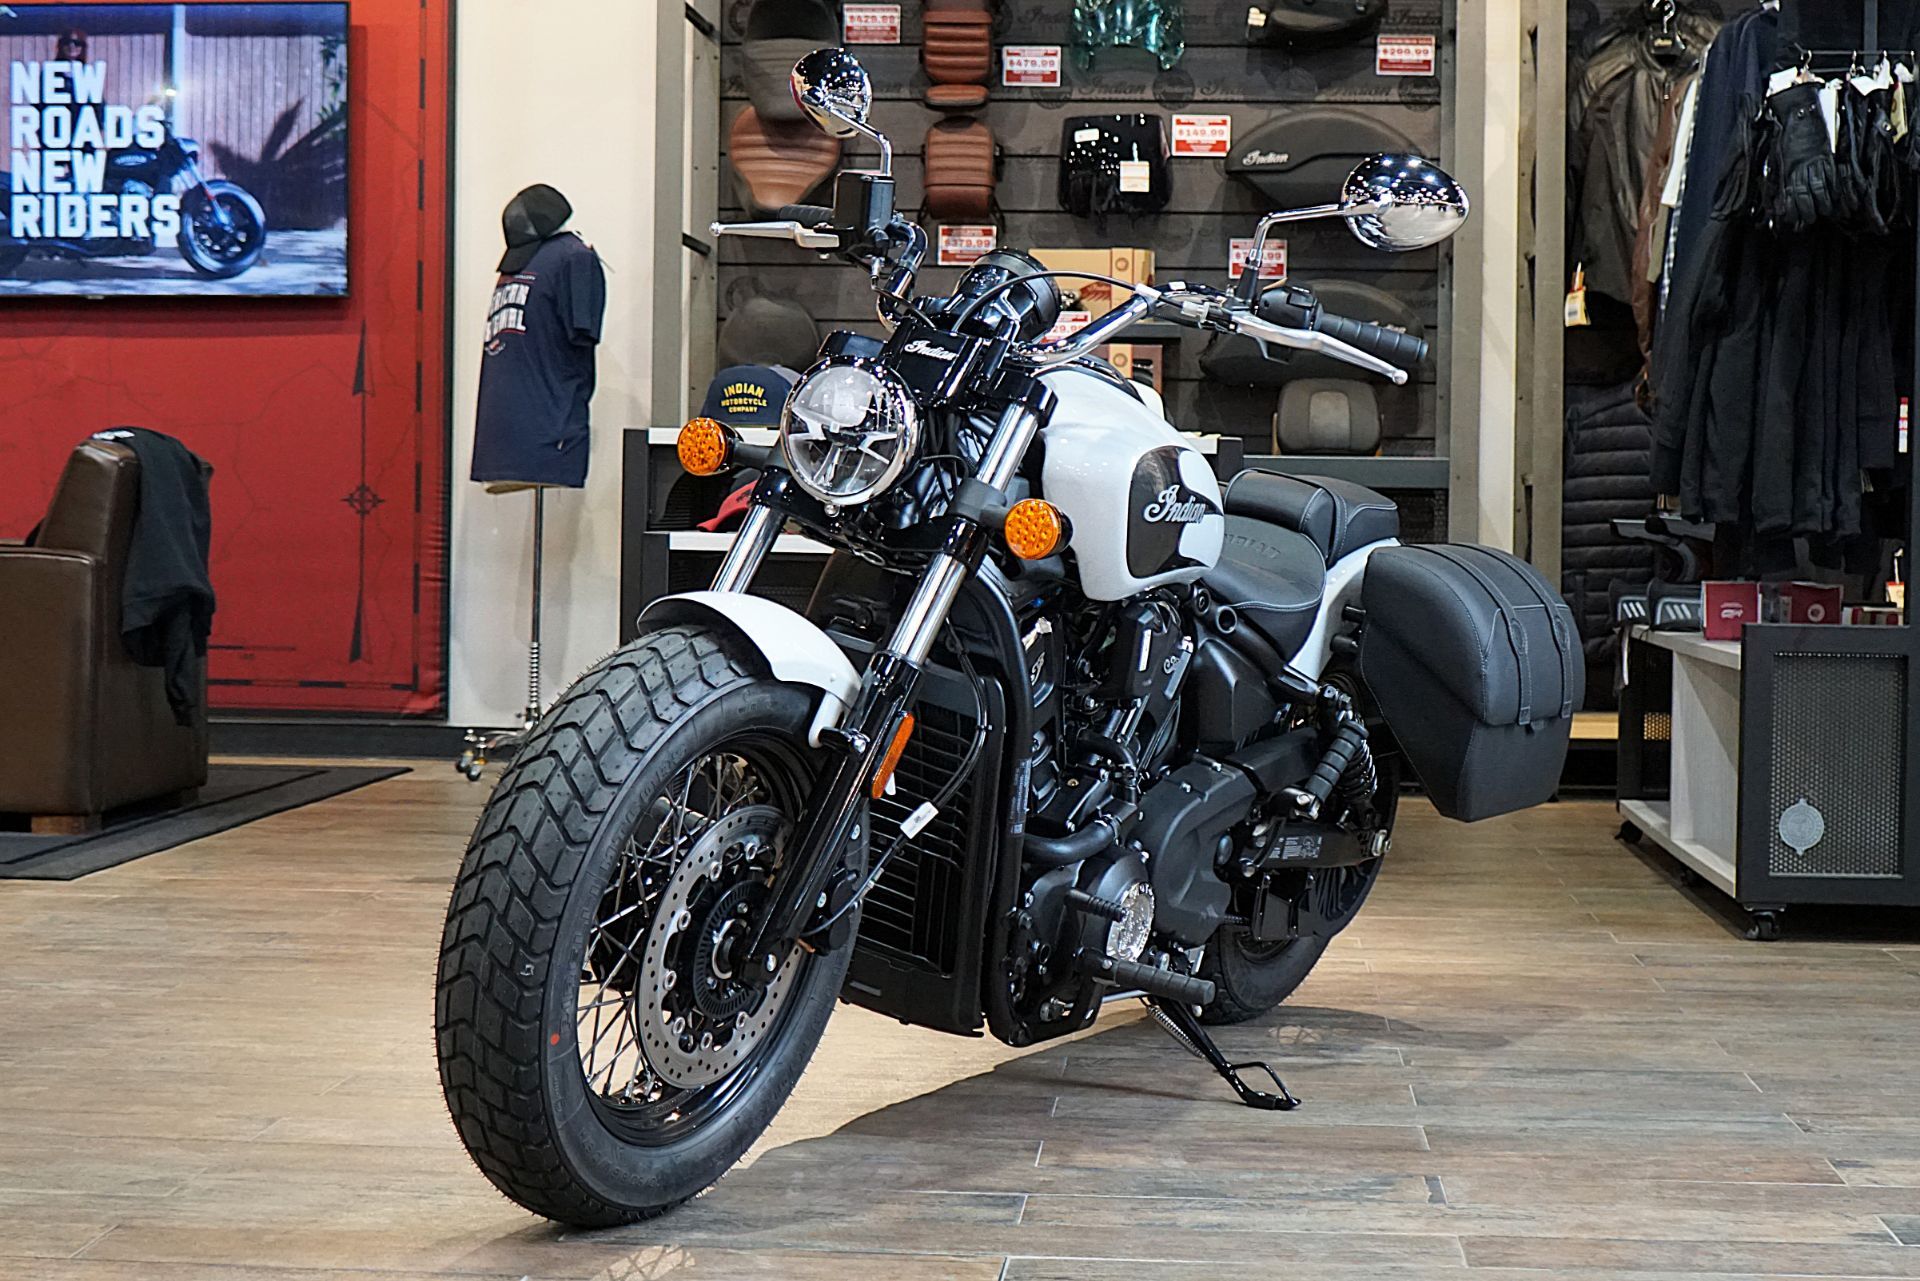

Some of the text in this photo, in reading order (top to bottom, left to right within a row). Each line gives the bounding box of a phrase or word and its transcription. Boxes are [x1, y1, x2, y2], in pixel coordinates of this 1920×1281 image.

[11, 61, 106, 104] NEW
[11, 105, 165, 149] ROADS
[11, 150, 106, 193] NEW
[1242, 150, 1289, 166] Indian
[11, 194, 181, 238] RIDERS
[904, 340, 958, 361] Indian
[721, 397, 767, 407] MOTORCYCLE
[723, 382, 765, 398] INDIAN
[1143, 484, 1206, 524] Indian
